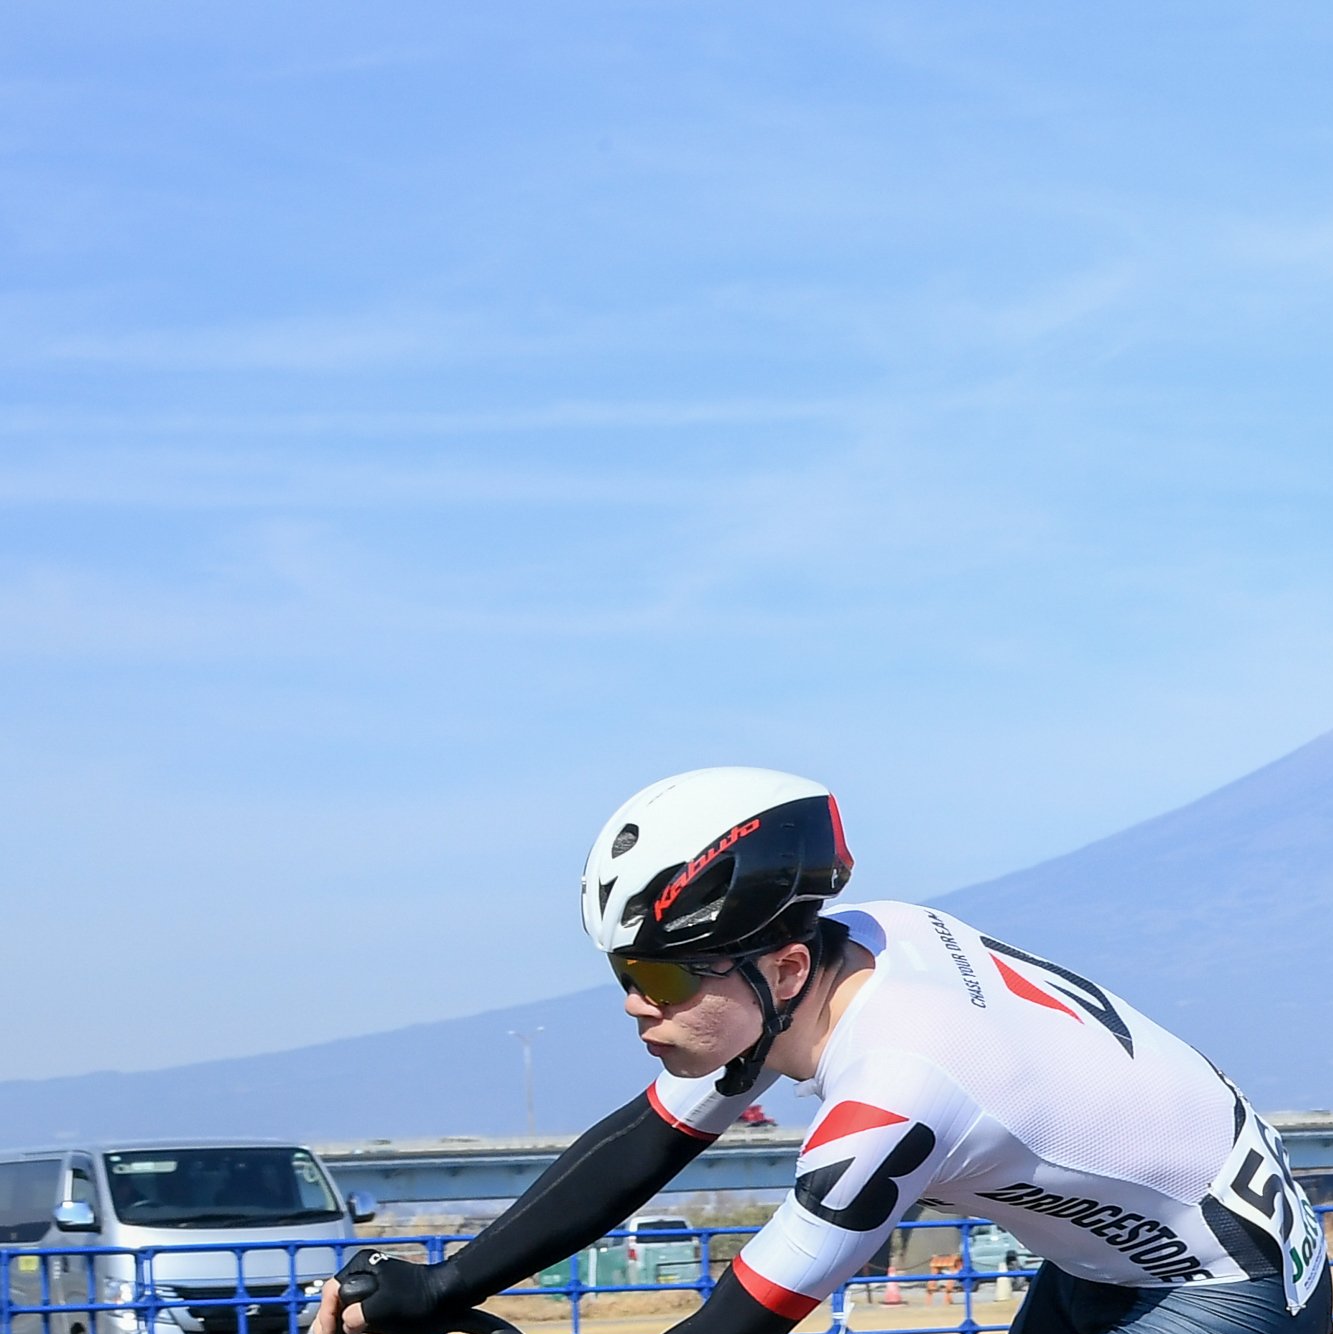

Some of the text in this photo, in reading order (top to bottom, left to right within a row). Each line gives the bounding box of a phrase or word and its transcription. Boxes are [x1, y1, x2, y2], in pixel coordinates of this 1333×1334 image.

[653, 818, 761, 922] Kabuto
[951, 953, 976, 978] YOUR
[963, 978, 986, 1008] CHASE
